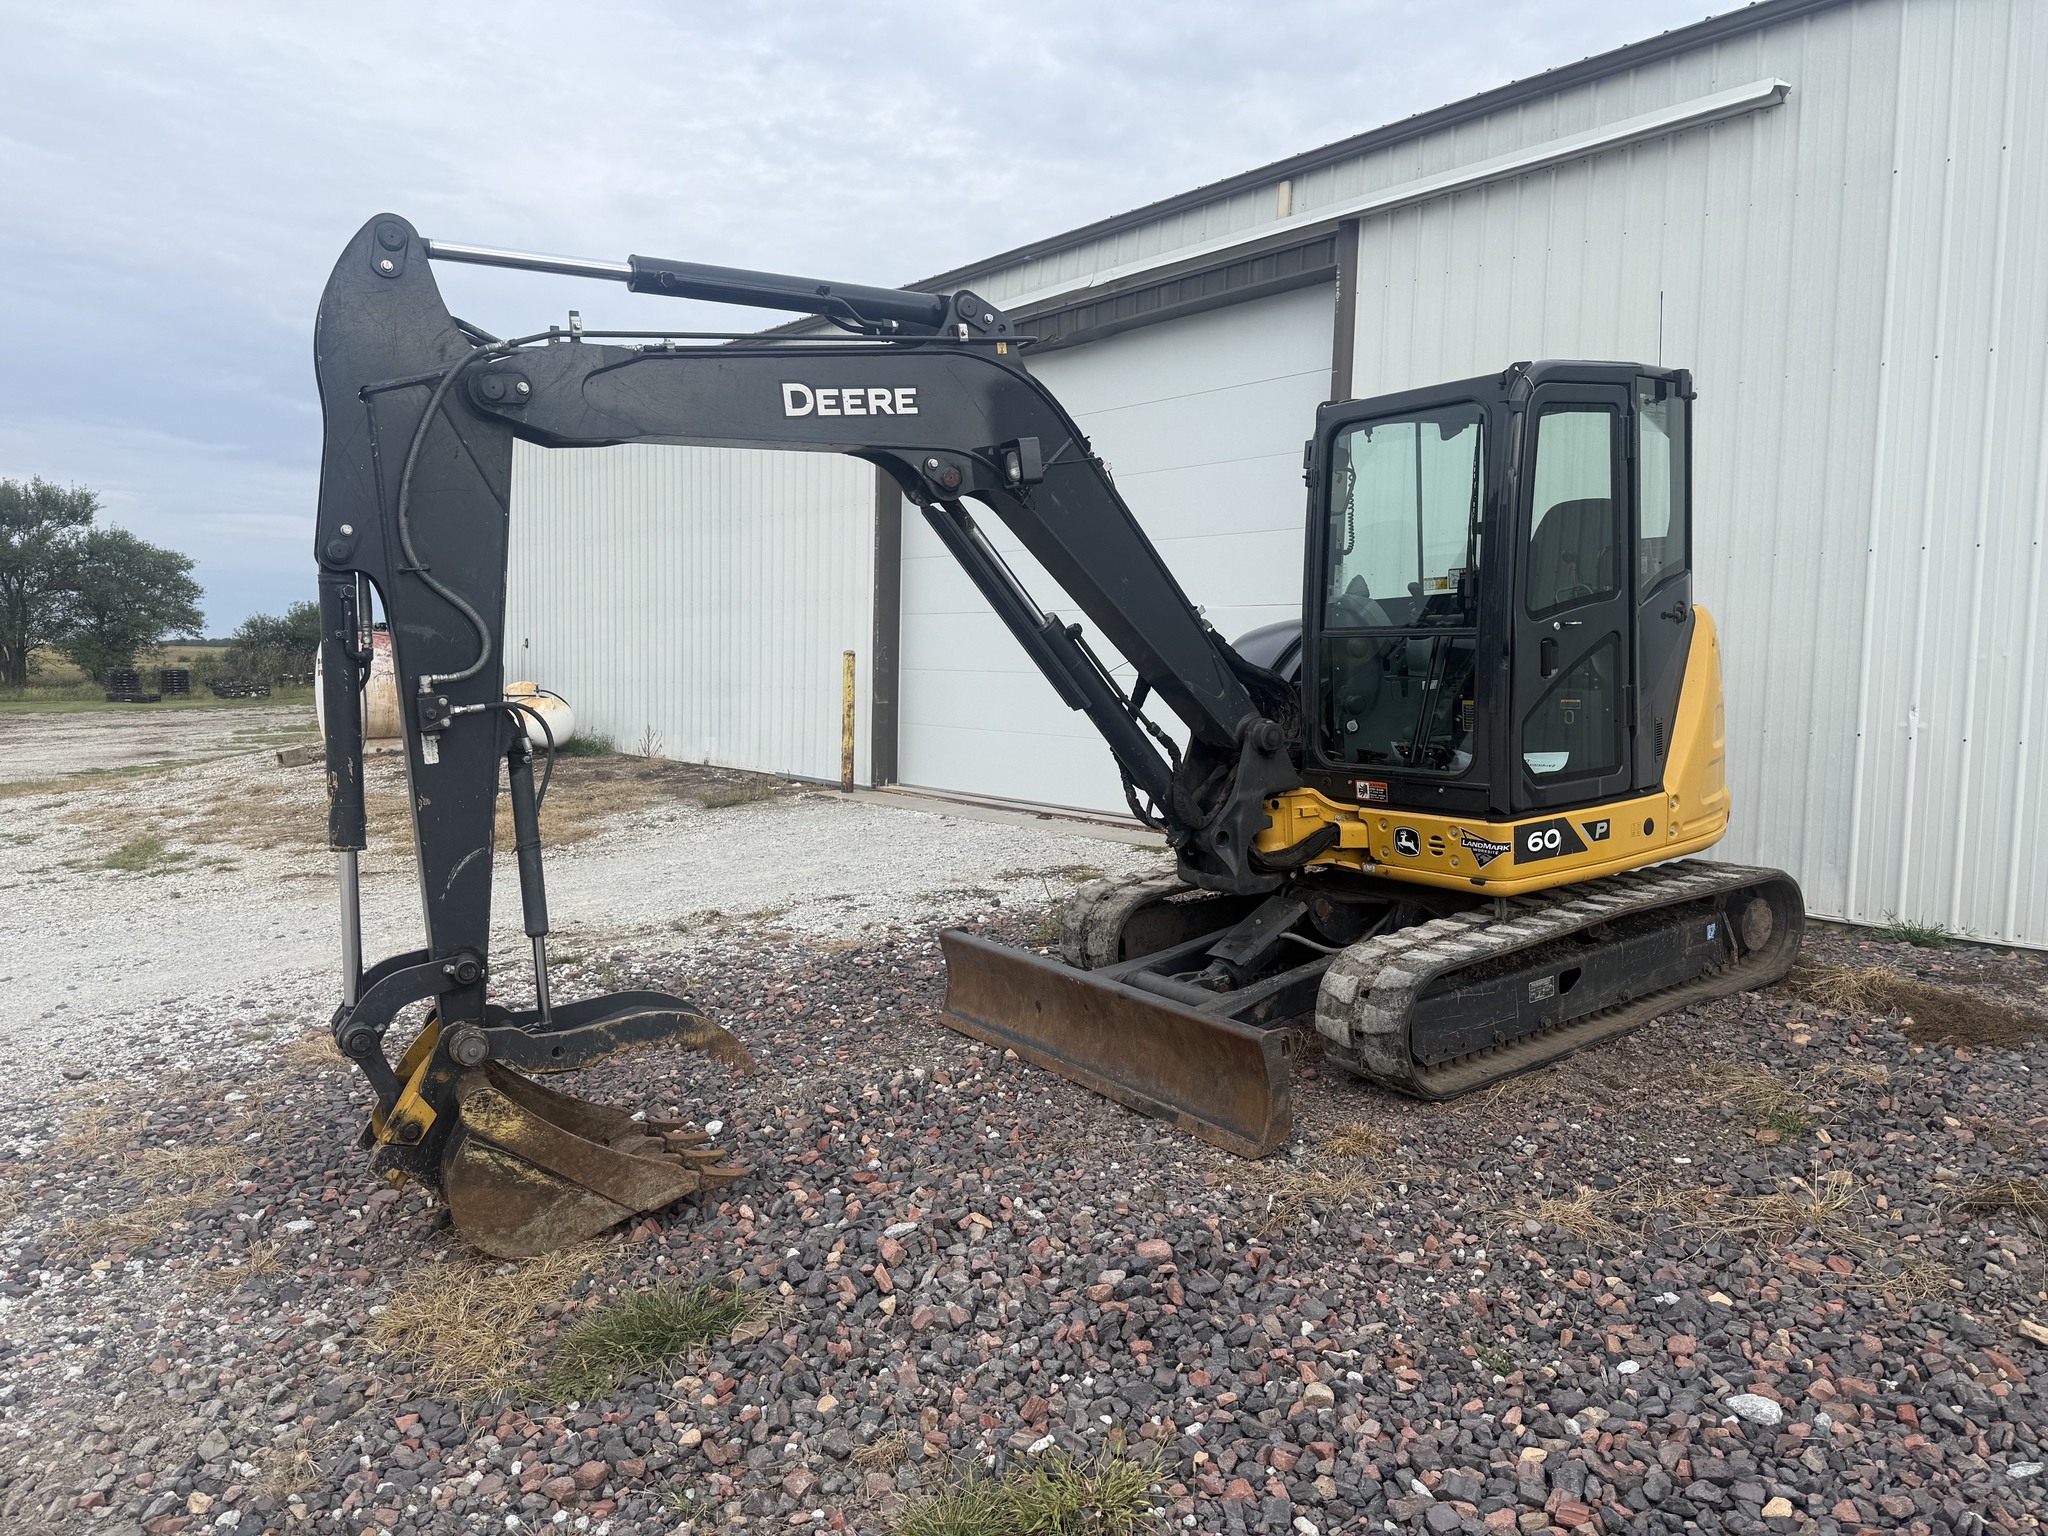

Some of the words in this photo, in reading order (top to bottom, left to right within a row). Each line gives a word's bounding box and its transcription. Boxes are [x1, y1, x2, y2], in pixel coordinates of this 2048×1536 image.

[782, 383, 919, 416] DEERE
[1462, 839, 1510, 851] LANDMARK
[1527, 828, 1561, 852] 60
[1595, 822, 1608, 839] P
